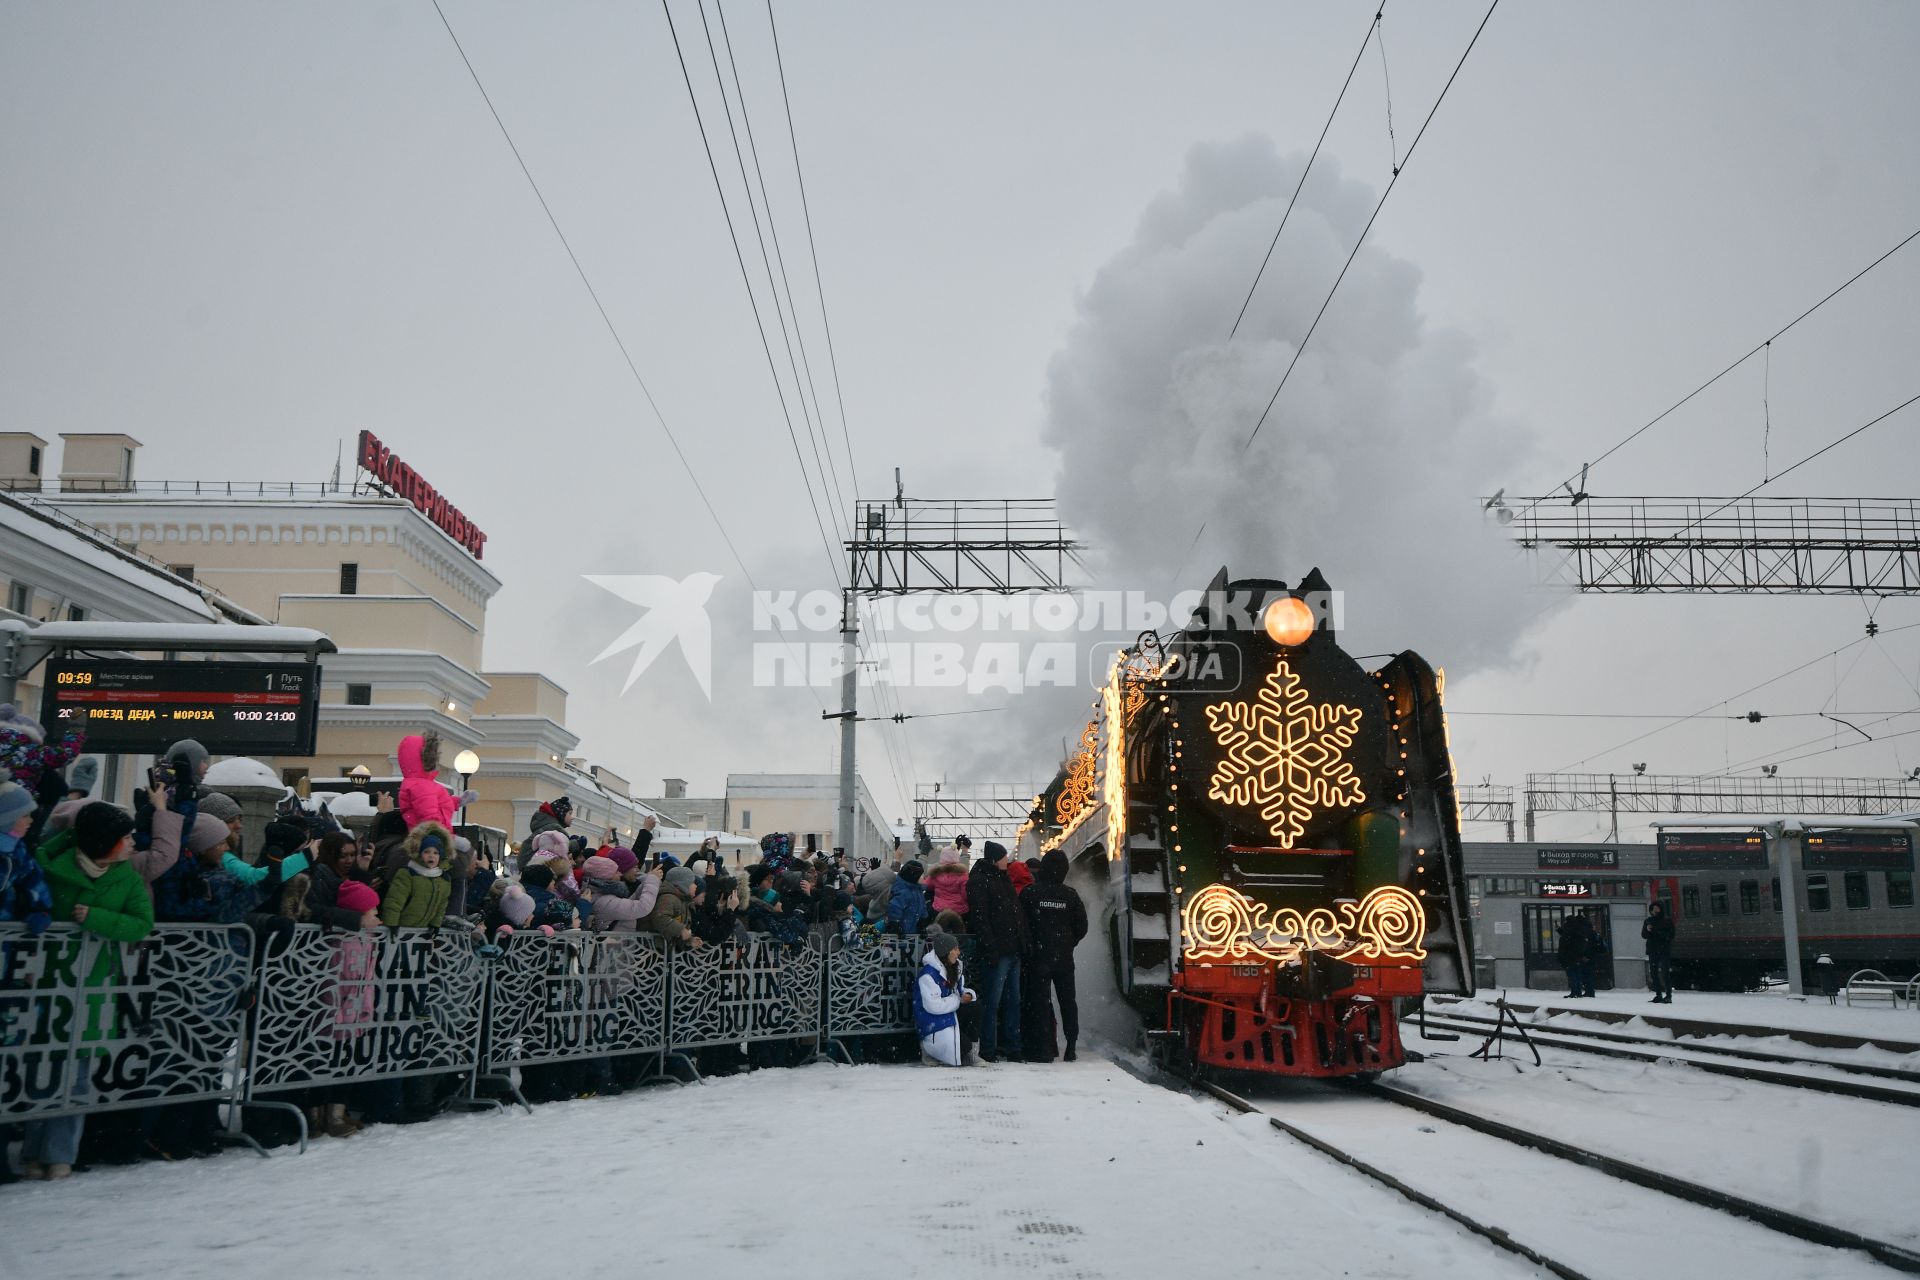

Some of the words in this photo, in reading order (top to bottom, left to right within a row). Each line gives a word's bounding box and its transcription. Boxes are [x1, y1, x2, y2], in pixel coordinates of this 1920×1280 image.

[358, 430, 487, 560] ЕКАТЕРИНБУРГ
[57, 672, 92, 684] 09:59
[265, 673, 273, 690] 1
[281, 673, 303, 684] Путь
[89, 709, 124, 720] ПОЕЗД
[127, 710, 156, 721] ДЕДА
[173, 711, 215, 720] МОРОЗА
[233, 711, 263, 721] 10:00
[264, 711, 296, 721] 21:00
[0, 941, 162, 989] EKAT
[720, 942, 782, 970] EKAT
[545, 978, 620, 1012] ERIN
[719, 972, 783, 1001] ERIN
[0, 992, 157, 1047] ERIN
[544, 1013, 619, 1050] BURG
[718, 1002, 782, 1033] BURG
[329, 1025, 424, 1068] BURG
